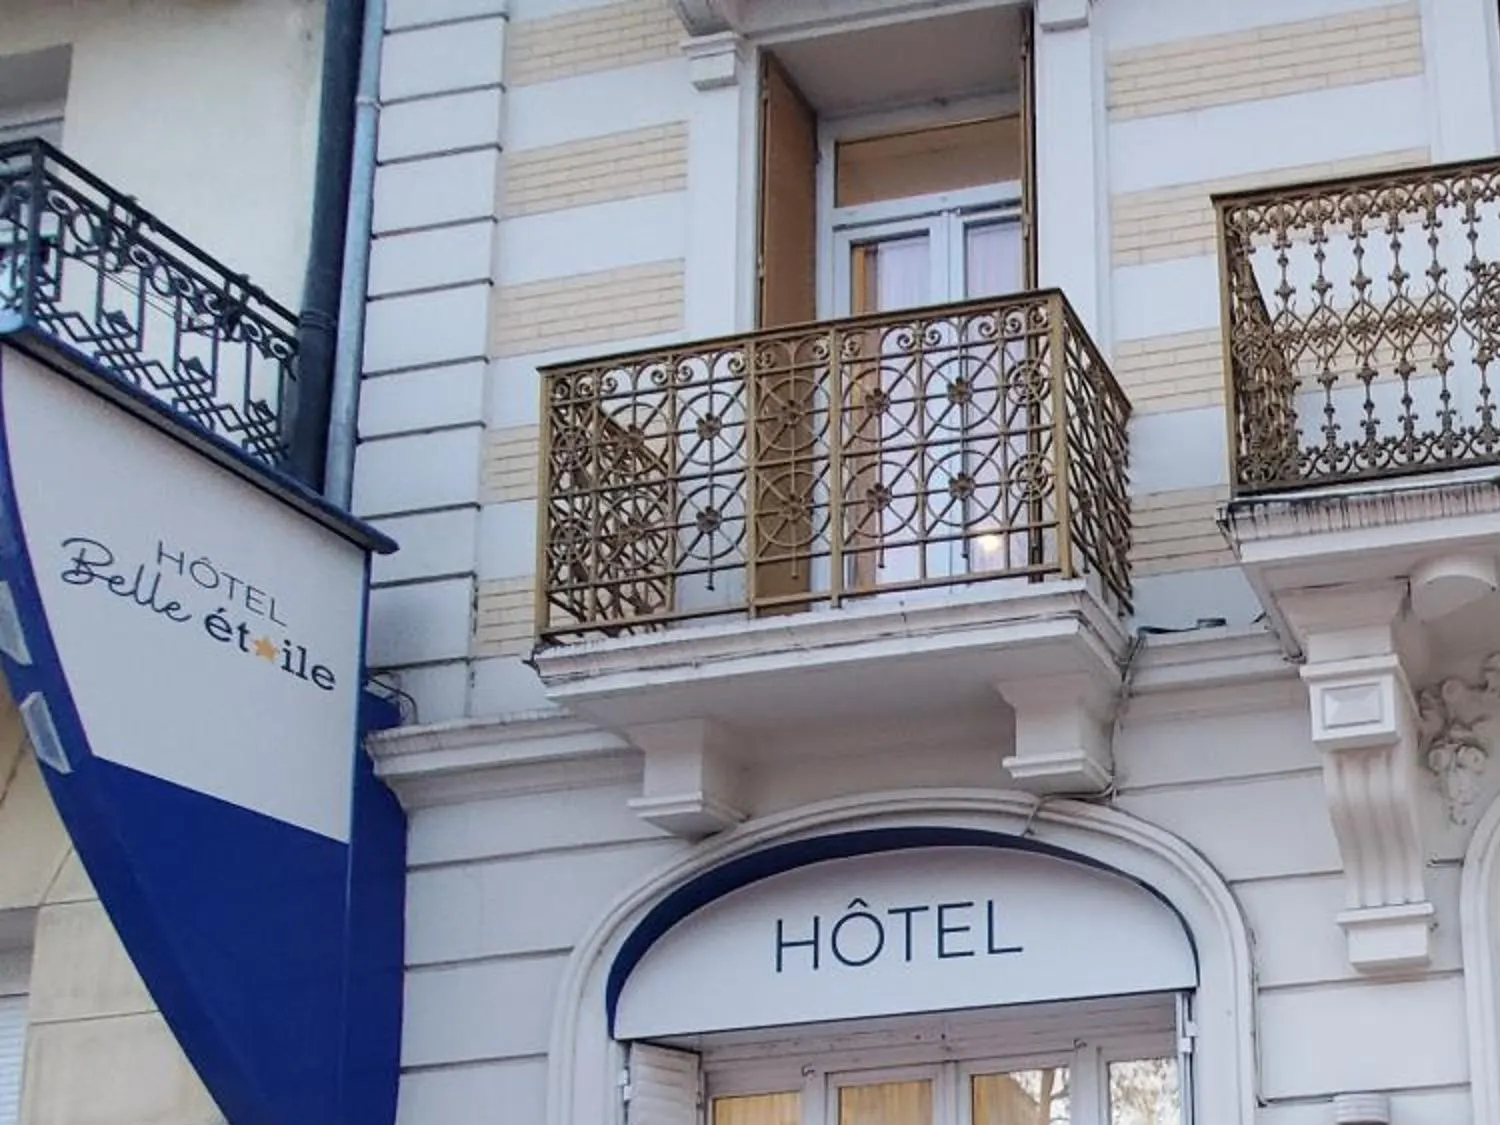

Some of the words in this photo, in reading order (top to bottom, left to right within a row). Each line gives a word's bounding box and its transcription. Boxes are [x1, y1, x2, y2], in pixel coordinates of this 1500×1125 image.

[61, 537, 192, 623] Belle
[156, 540, 288, 627] HÔTEL
[775, 897, 1024, 973] HÔTEL
